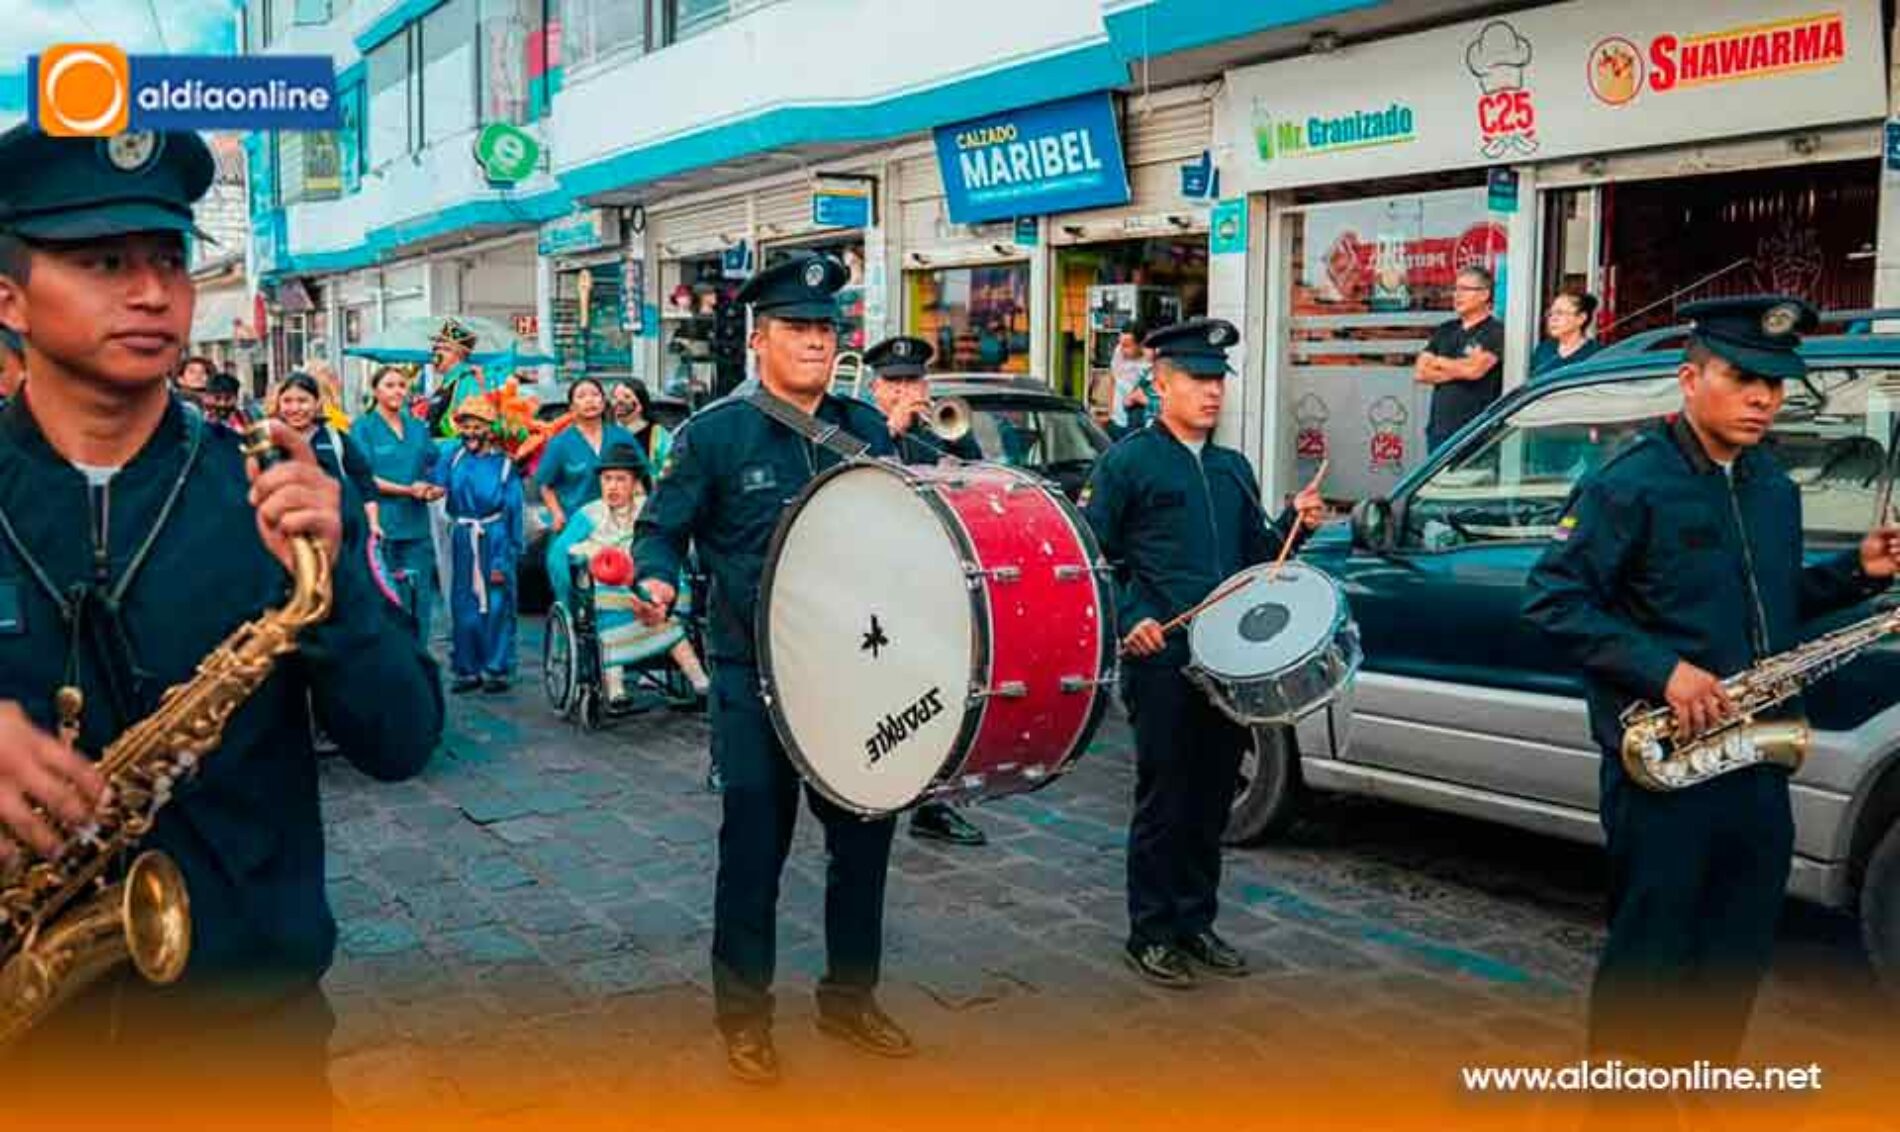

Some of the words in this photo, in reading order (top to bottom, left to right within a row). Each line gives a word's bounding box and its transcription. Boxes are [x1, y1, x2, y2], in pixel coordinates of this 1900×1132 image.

[1649, 20, 1844, 92] SHAWARMA
[1307, 103, 1412, 146] Granizado
[1479, 91, 1533, 133] C25
[955, 122, 1017, 149] CALZADO
[959, 129, 1102, 189] MARIBEL
[1371, 432, 1403, 461] C25
